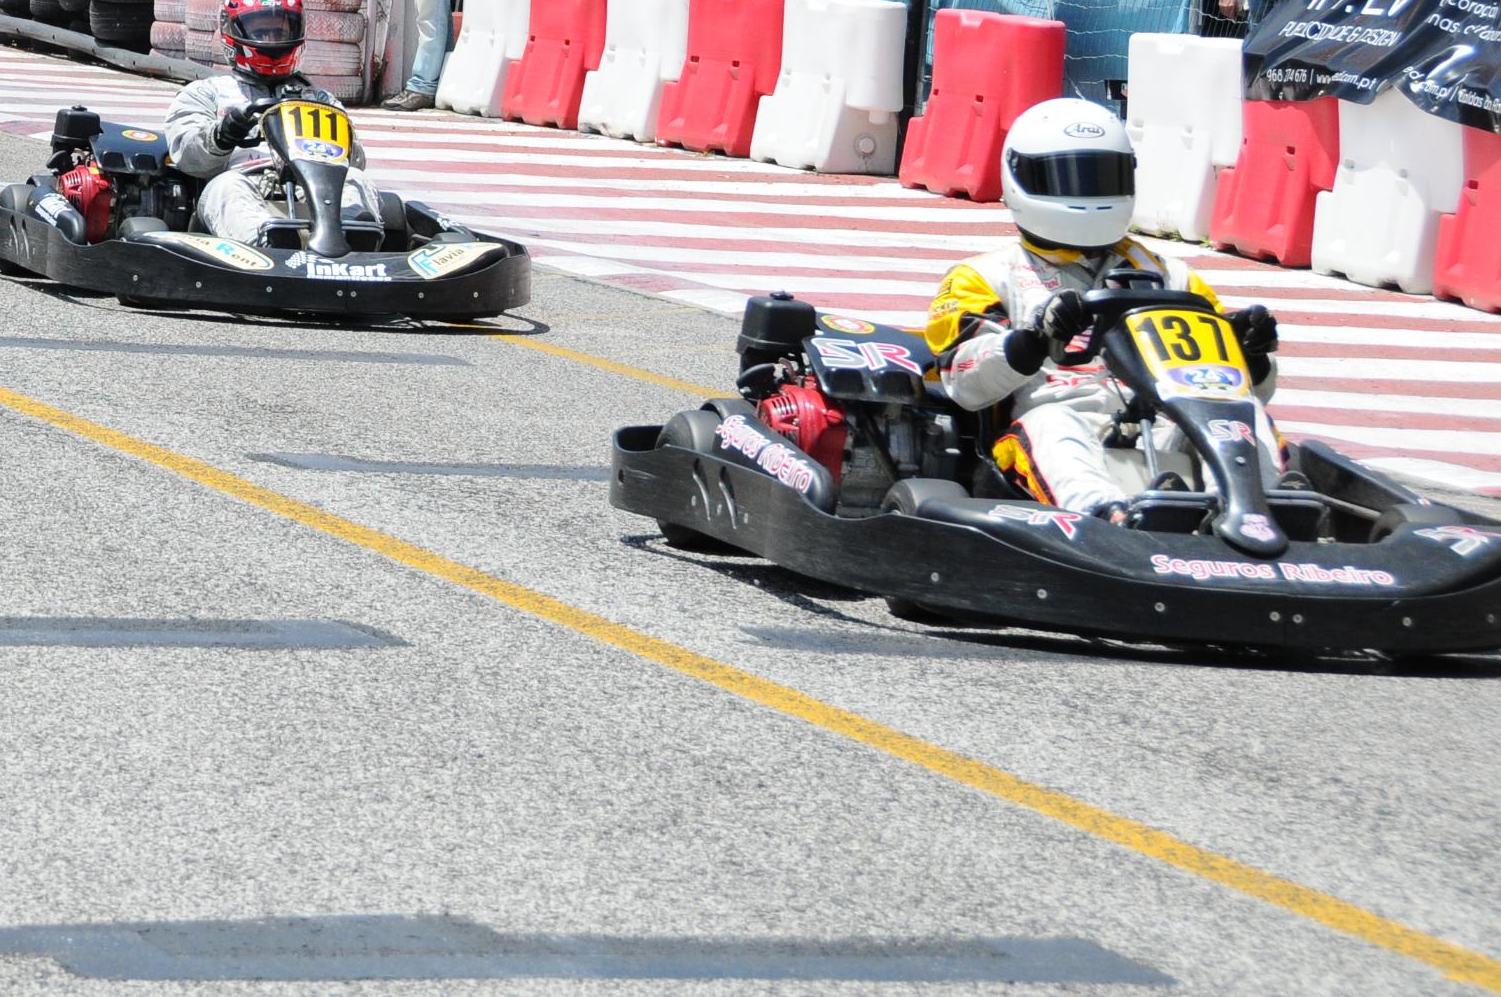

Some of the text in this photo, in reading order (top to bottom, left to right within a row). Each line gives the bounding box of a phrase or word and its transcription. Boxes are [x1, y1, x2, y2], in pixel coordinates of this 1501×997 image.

[287, 106, 338, 142] 111
[306, 262, 387, 277] InKart
[1134, 315, 1230, 362] 137
[810, 337, 923, 377] SR
[1207, 418, 1257, 447] SR
[1150, 554, 1395, 586] Seguros Ribeiro
